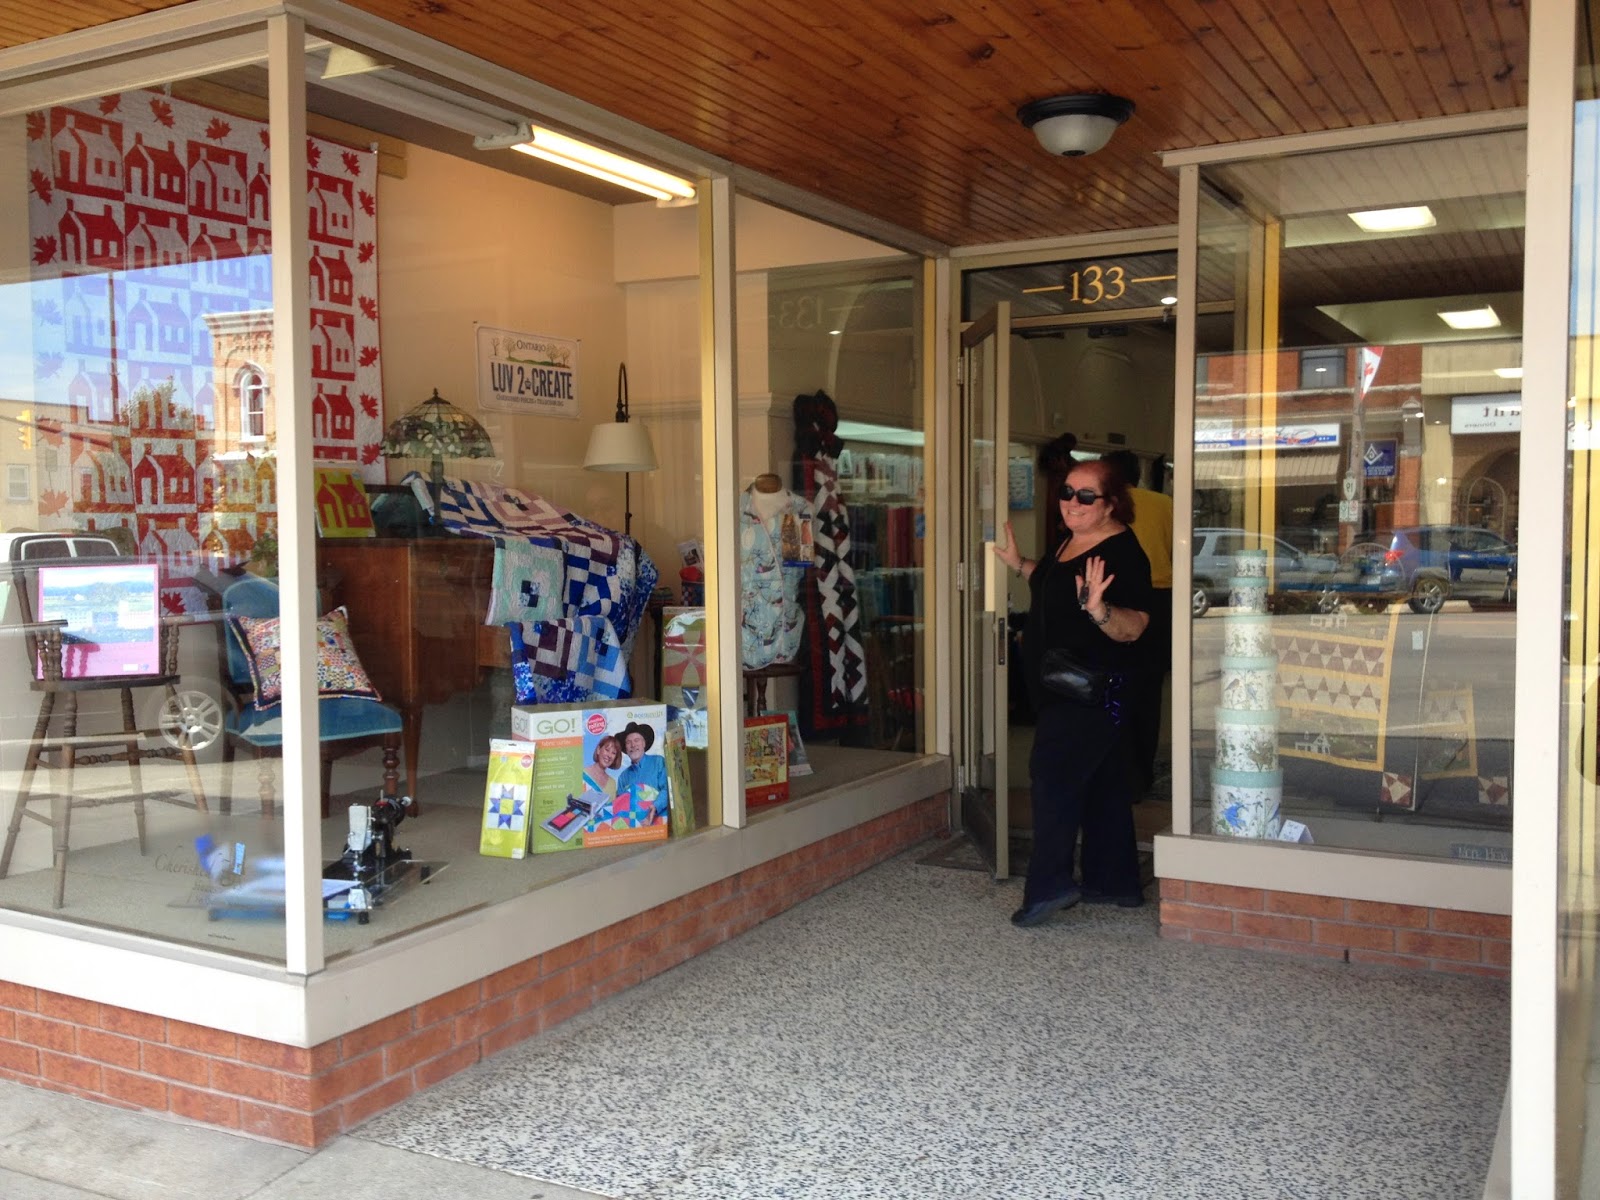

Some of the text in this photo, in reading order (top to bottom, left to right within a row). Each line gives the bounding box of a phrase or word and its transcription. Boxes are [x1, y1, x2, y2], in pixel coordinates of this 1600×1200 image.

[1070, 264, 1126, 305] 133
[490, 361, 574, 400] LUV 2 CREATE
[536, 718, 576, 735] GO!
